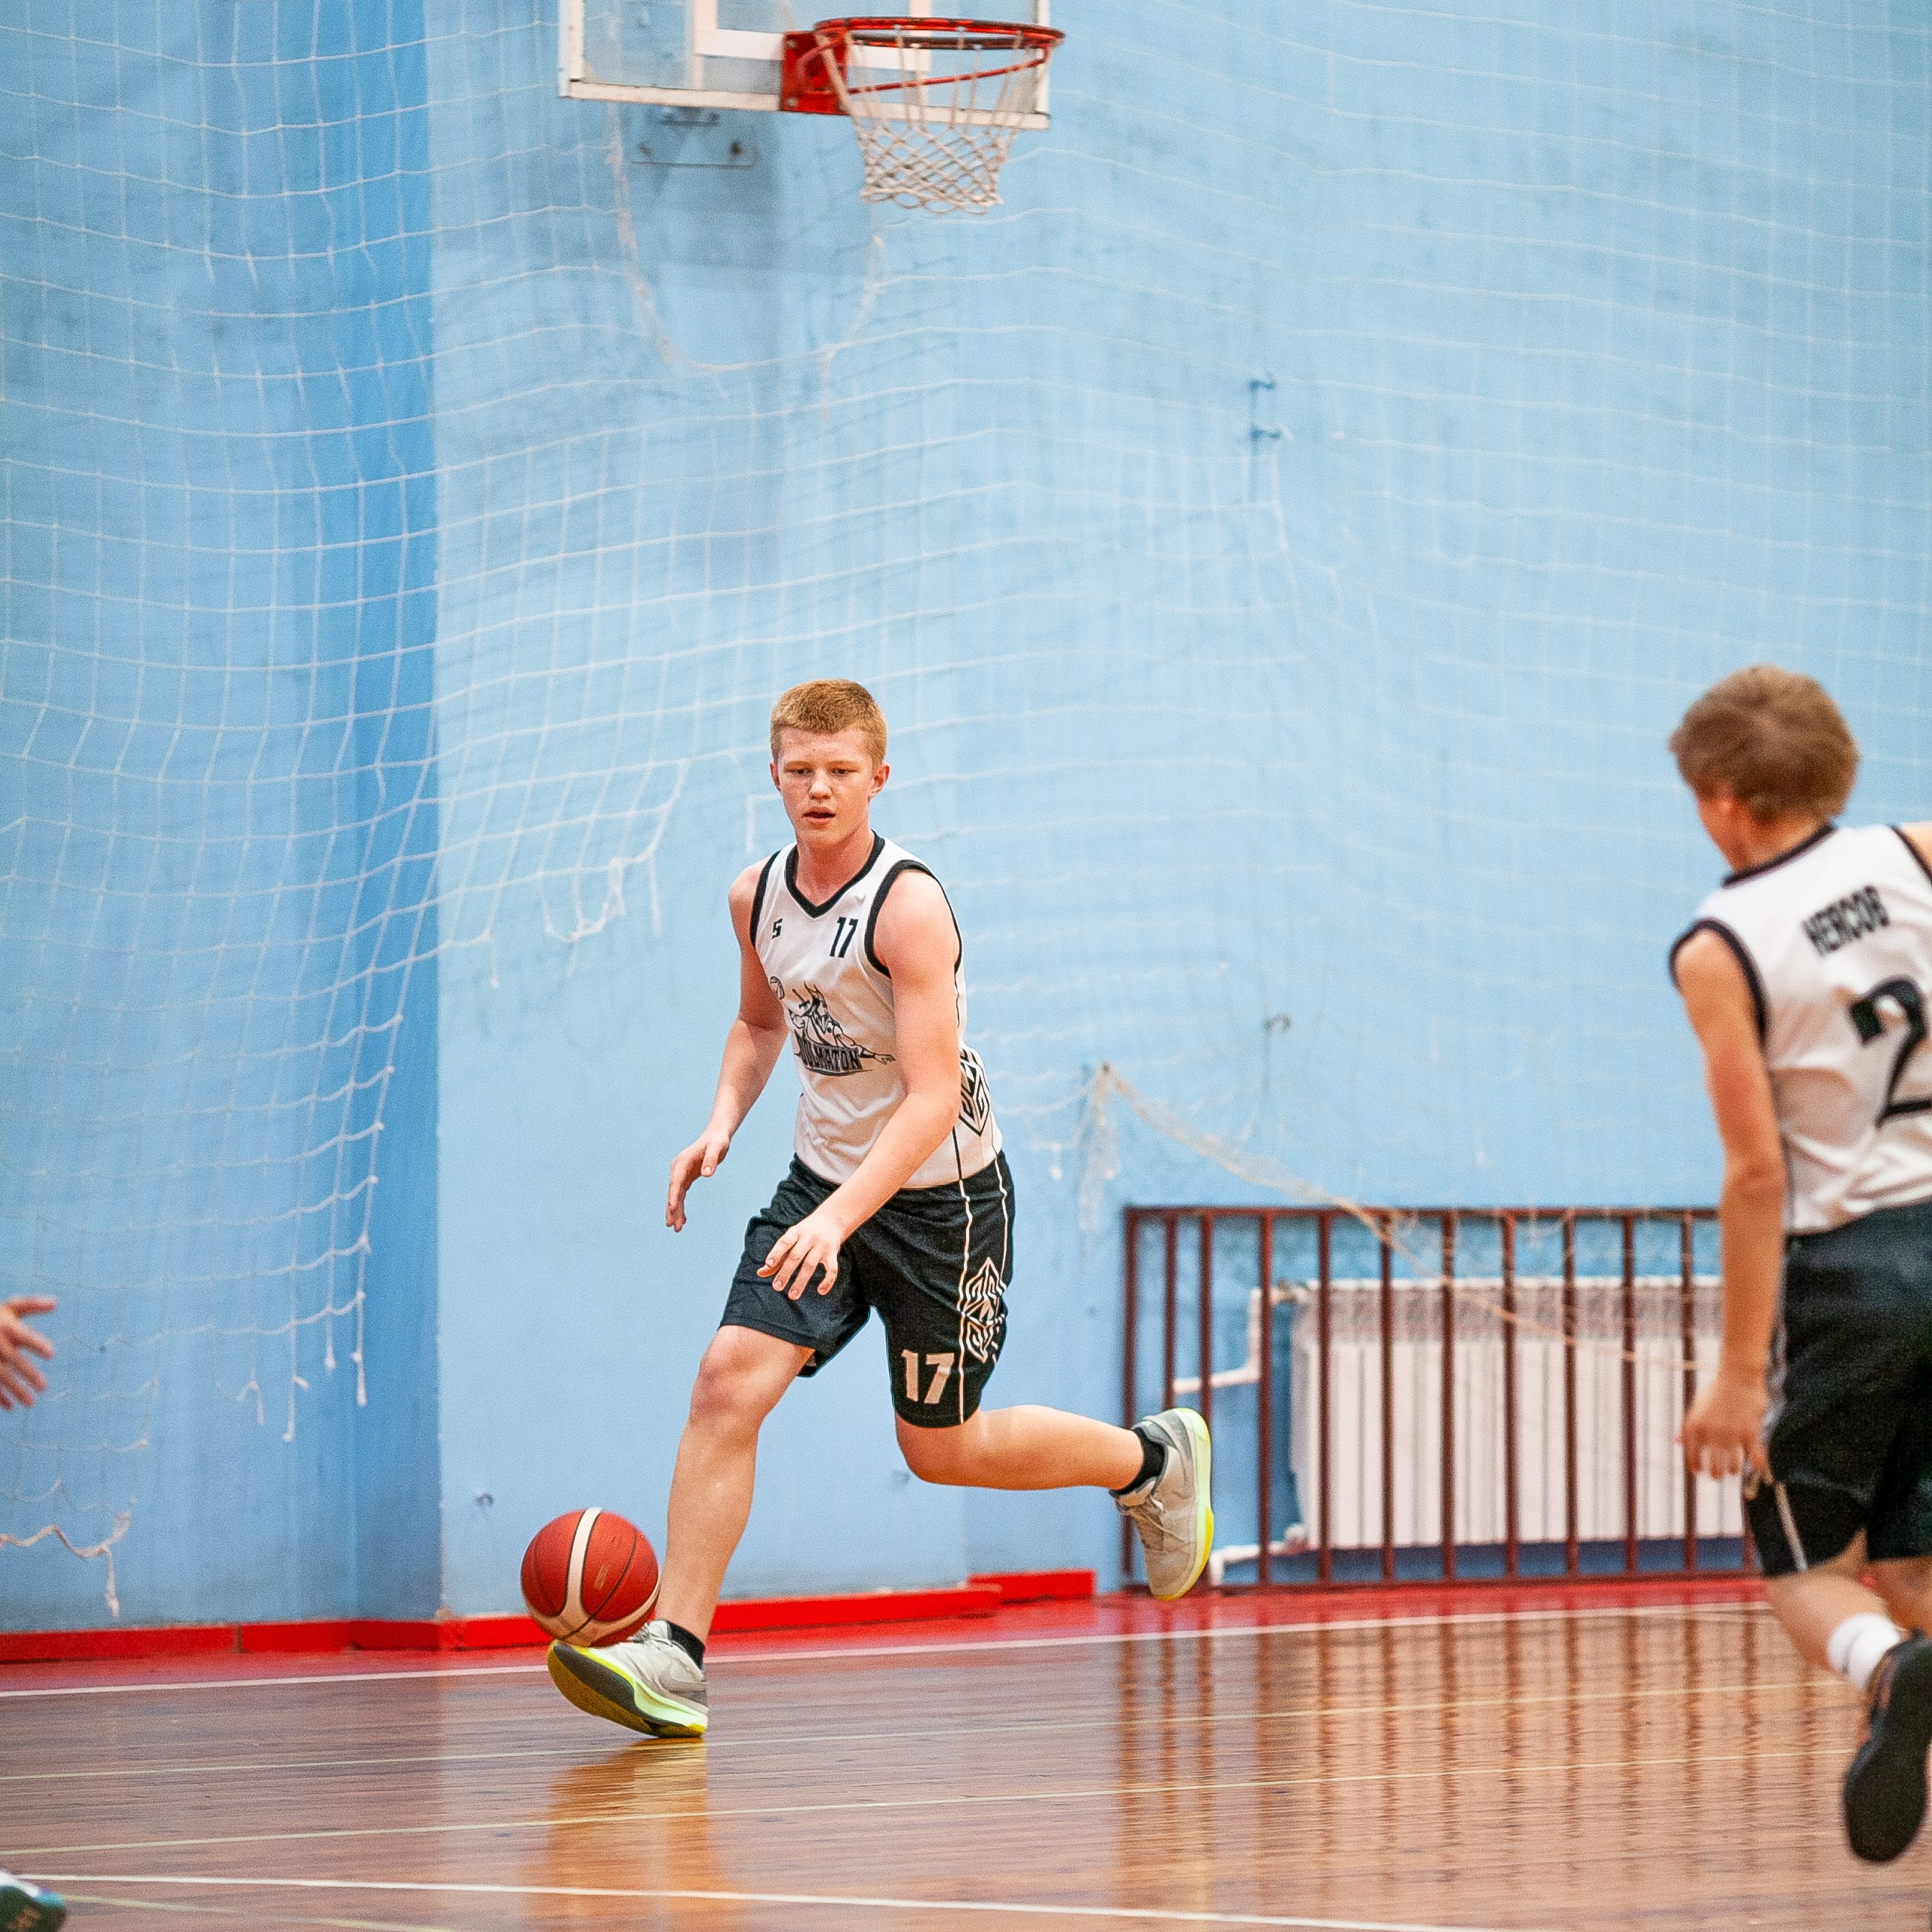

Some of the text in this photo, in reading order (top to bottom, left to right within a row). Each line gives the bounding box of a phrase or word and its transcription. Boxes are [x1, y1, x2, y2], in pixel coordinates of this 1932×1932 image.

[829, 916, 859, 958] 17
[1849, 976, 1932, 1128] 2
[901, 1349, 955, 1404] 17
